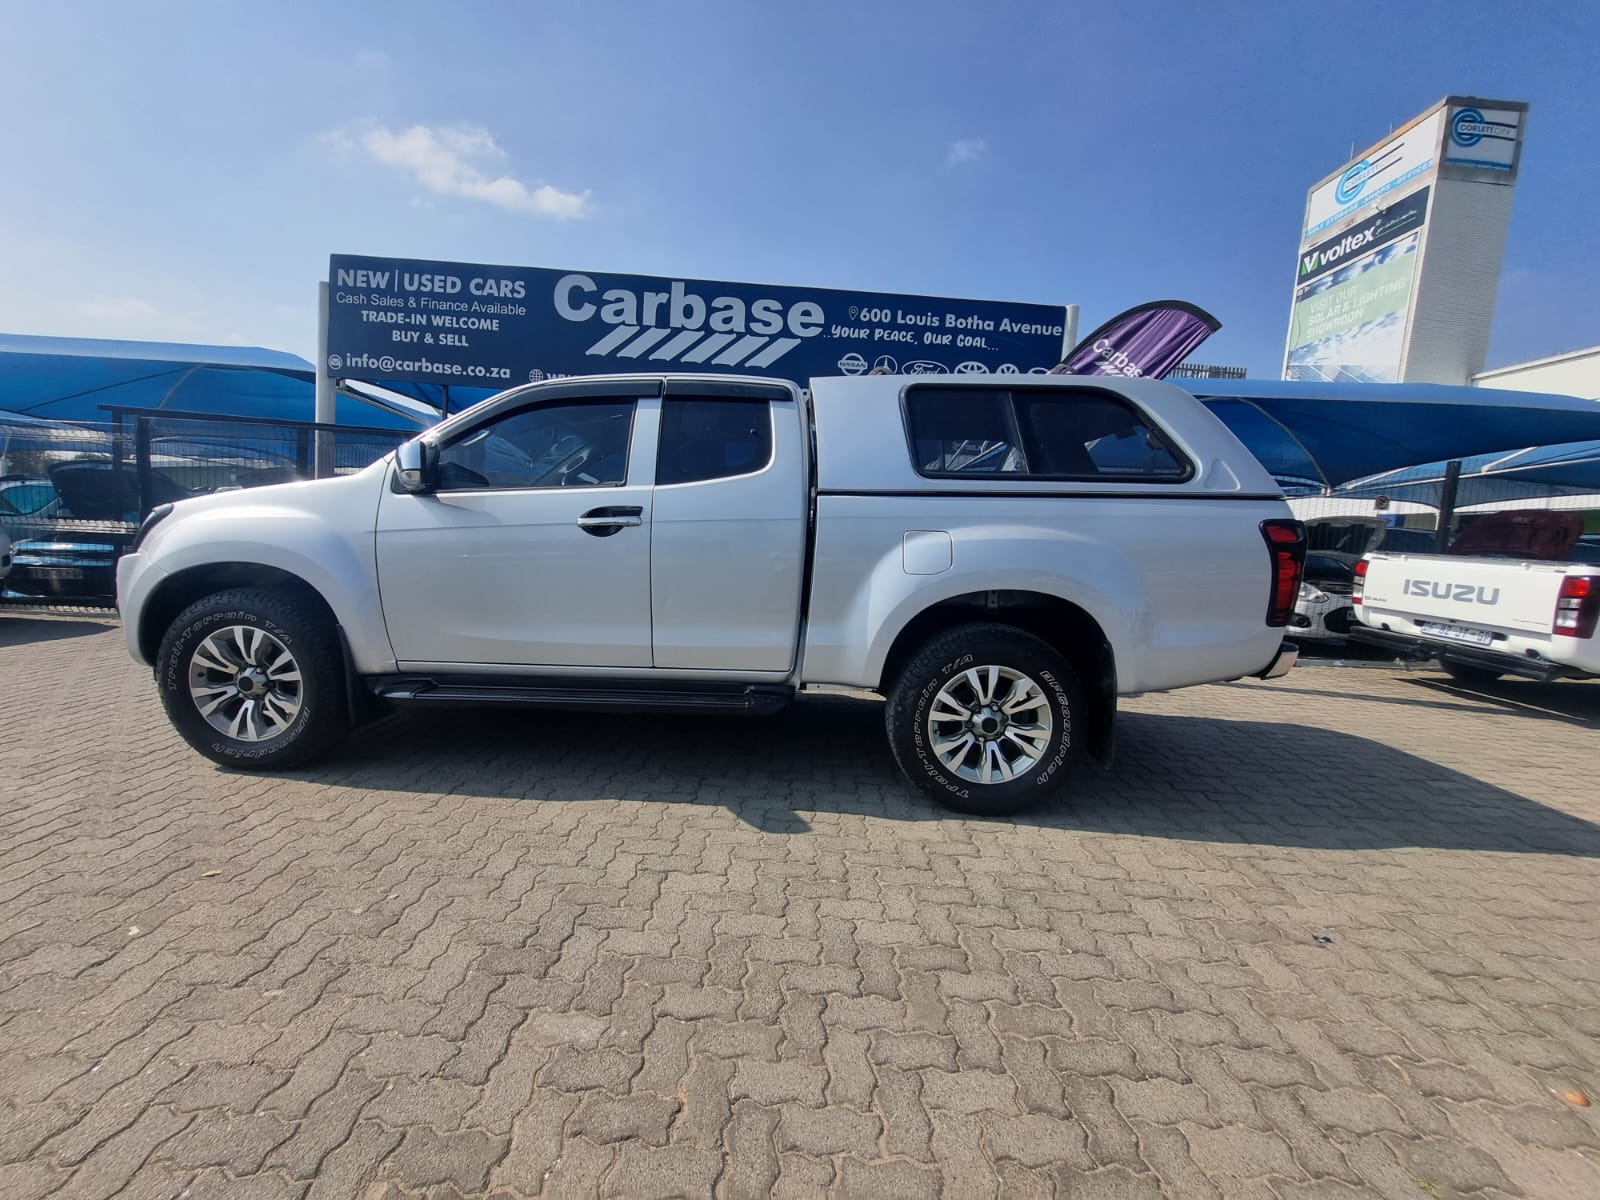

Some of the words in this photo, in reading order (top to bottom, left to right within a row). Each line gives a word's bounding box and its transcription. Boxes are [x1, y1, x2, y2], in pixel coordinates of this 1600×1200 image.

[1320, 226, 1375, 266] voltex
[337, 269, 390, 289] NEW
[403, 273, 462, 294] USED
[469, 277, 526, 299] CARS
[336, 291, 367, 305] Cash
[370, 294, 404, 308] Sales
[408, 296, 417, 308] &
[421, 297, 468, 312] Finance
[471, 302, 526, 316] Available
[553, 274, 825, 338] Carbase
[1308, 304, 1341, 326] SOLAR
[1353, 277, 1407, 308] LIGHTING
[1310, 294, 1336, 313] VISIT
[1336, 285, 1358, 302] OUR
[361, 310, 427, 326] TRADE-IN
[431, 315, 500, 331] WELCOME
[860, 307, 891, 323] 600
[897, 309, 940, 327] Louis
[945, 313, 995, 331] Botha
[999, 318, 1063, 336] Avenue
[1306, 308, 1364, 338] SHOWROOM
[392, 330, 420, 343] BUY
[424, 333, 434, 345] &
[438, 334, 469, 347] SELL
[875, 327, 919, 345] PEACE,
[923, 331, 952, 345] OUR
[346, 353, 511, 379] info@carbase.co.za
[839, 361, 867, 370] NISSAN
[910, 363, 941, 375] Ford
[1092, 338, 1150, 378] Carbas
[1403, 578, 1500, 606] ISUZU
[264, 620, 293, 645] T/A
[941, 654, 974, 676] T/A
[1036, 670, 1071, 786] BFGoodrich
